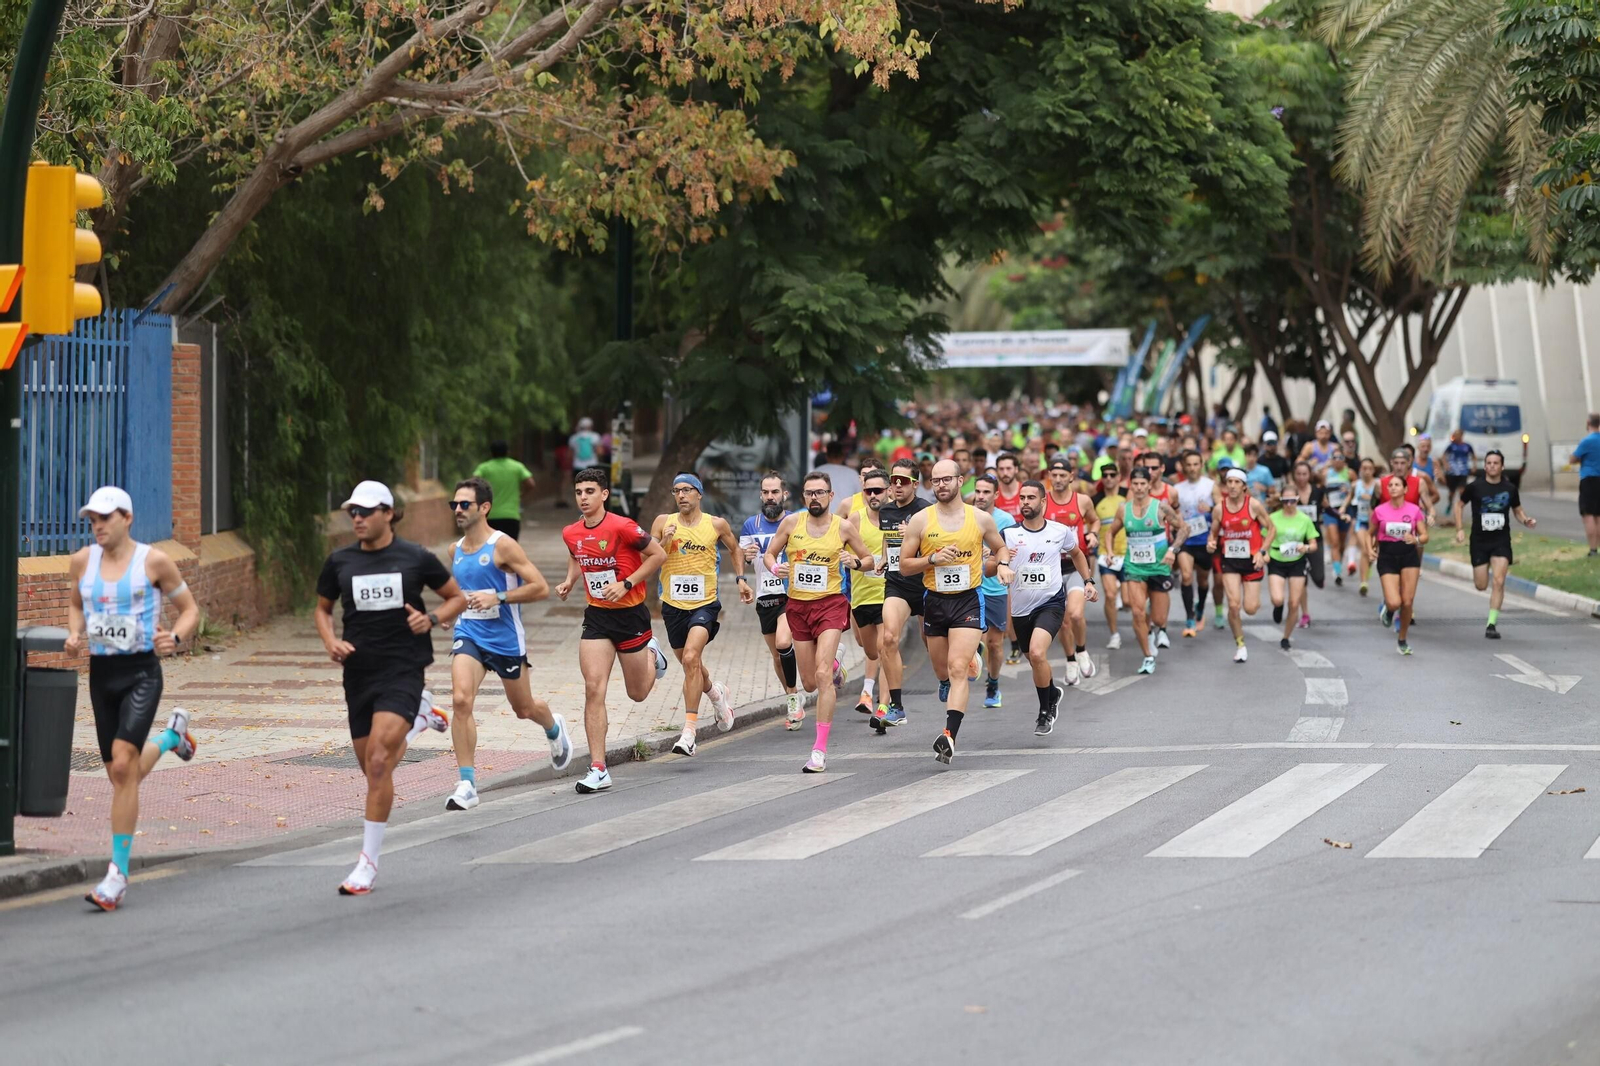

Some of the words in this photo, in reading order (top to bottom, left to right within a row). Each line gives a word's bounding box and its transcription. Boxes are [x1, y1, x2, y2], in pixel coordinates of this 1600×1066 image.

[798, 573, 822, 584] 692
[943, 574, 960, 584] 33
[1022, 573, 1046, 583] 790
[360, 586, 393, 600] 859
[674, 583, 699, 593] 796
[94, 625, 127, 639] 344
